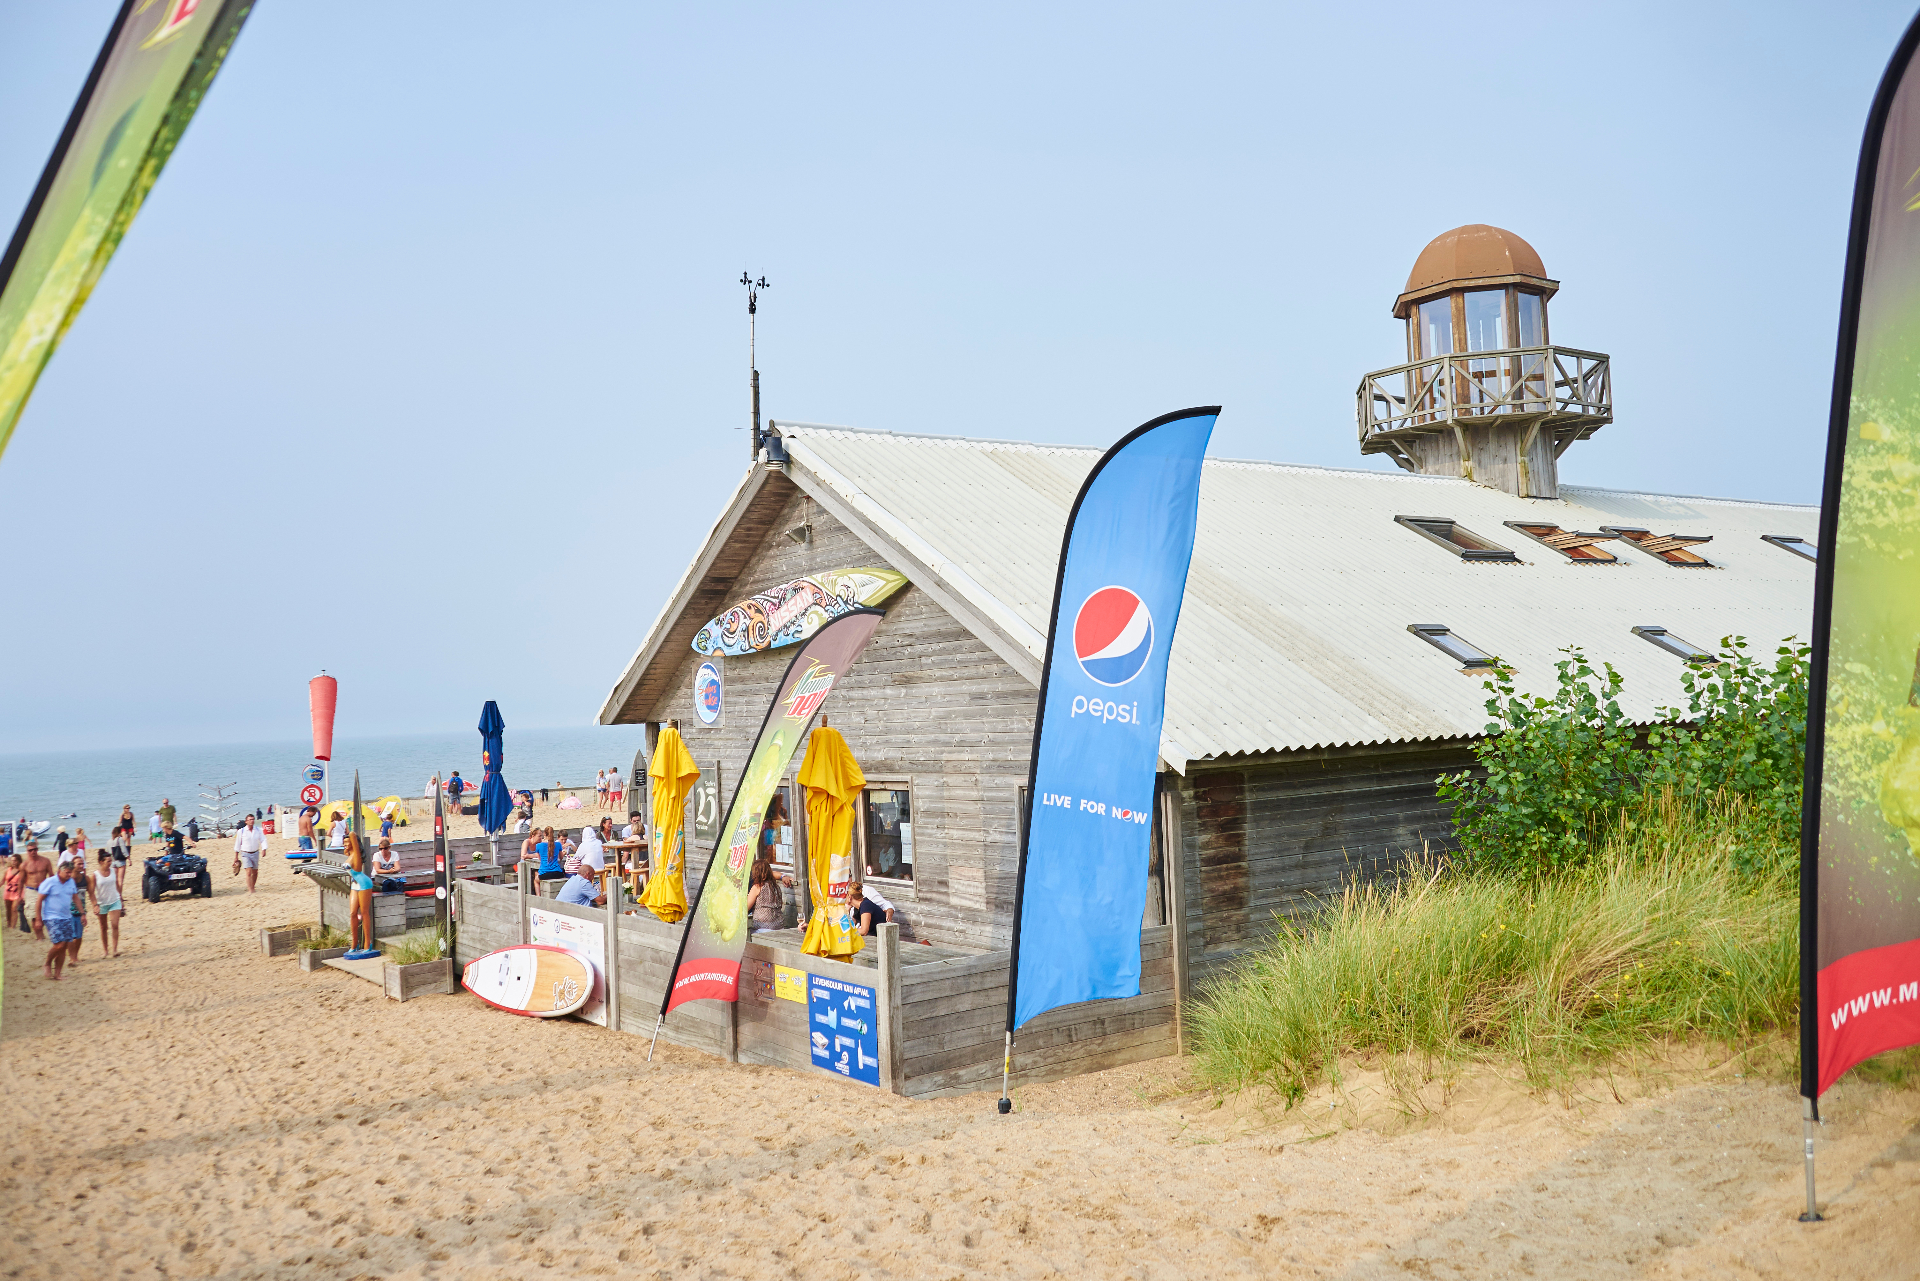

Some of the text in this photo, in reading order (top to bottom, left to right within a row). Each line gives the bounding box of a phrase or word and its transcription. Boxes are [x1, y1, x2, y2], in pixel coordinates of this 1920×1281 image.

[769, 587, 813, 630] NISSAN
[1071, 695, 1139, 725] pepsi
[1043, 793, 1148, 824] LIVE FOR NOW
[1831, 981, 1920, 1031] WWW.M
